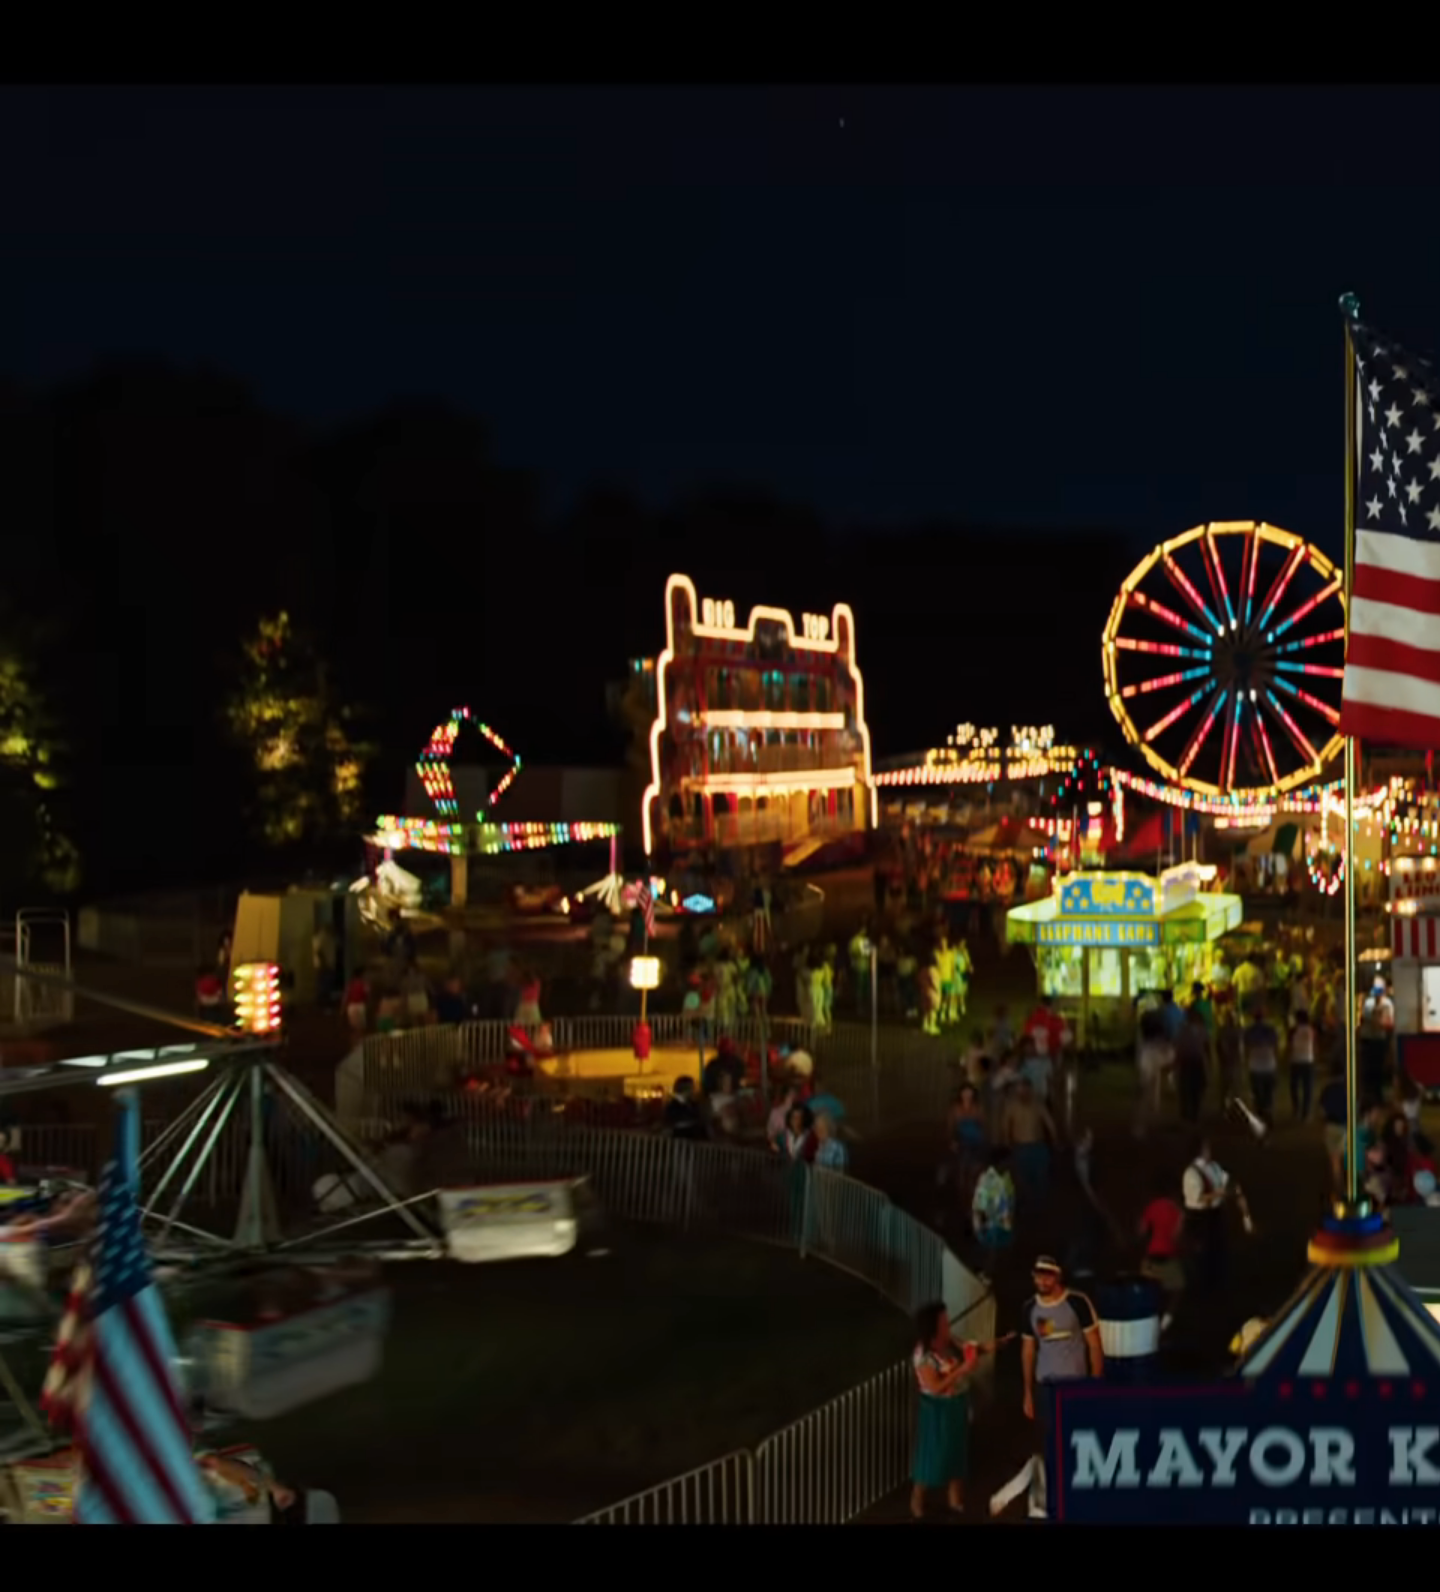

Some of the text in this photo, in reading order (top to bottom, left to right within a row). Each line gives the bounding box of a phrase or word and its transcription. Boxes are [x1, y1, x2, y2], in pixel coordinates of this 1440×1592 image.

[702, 598, 829, 640] BIG TOP
[1070, 1427, 1356, 1489] MAYOR
